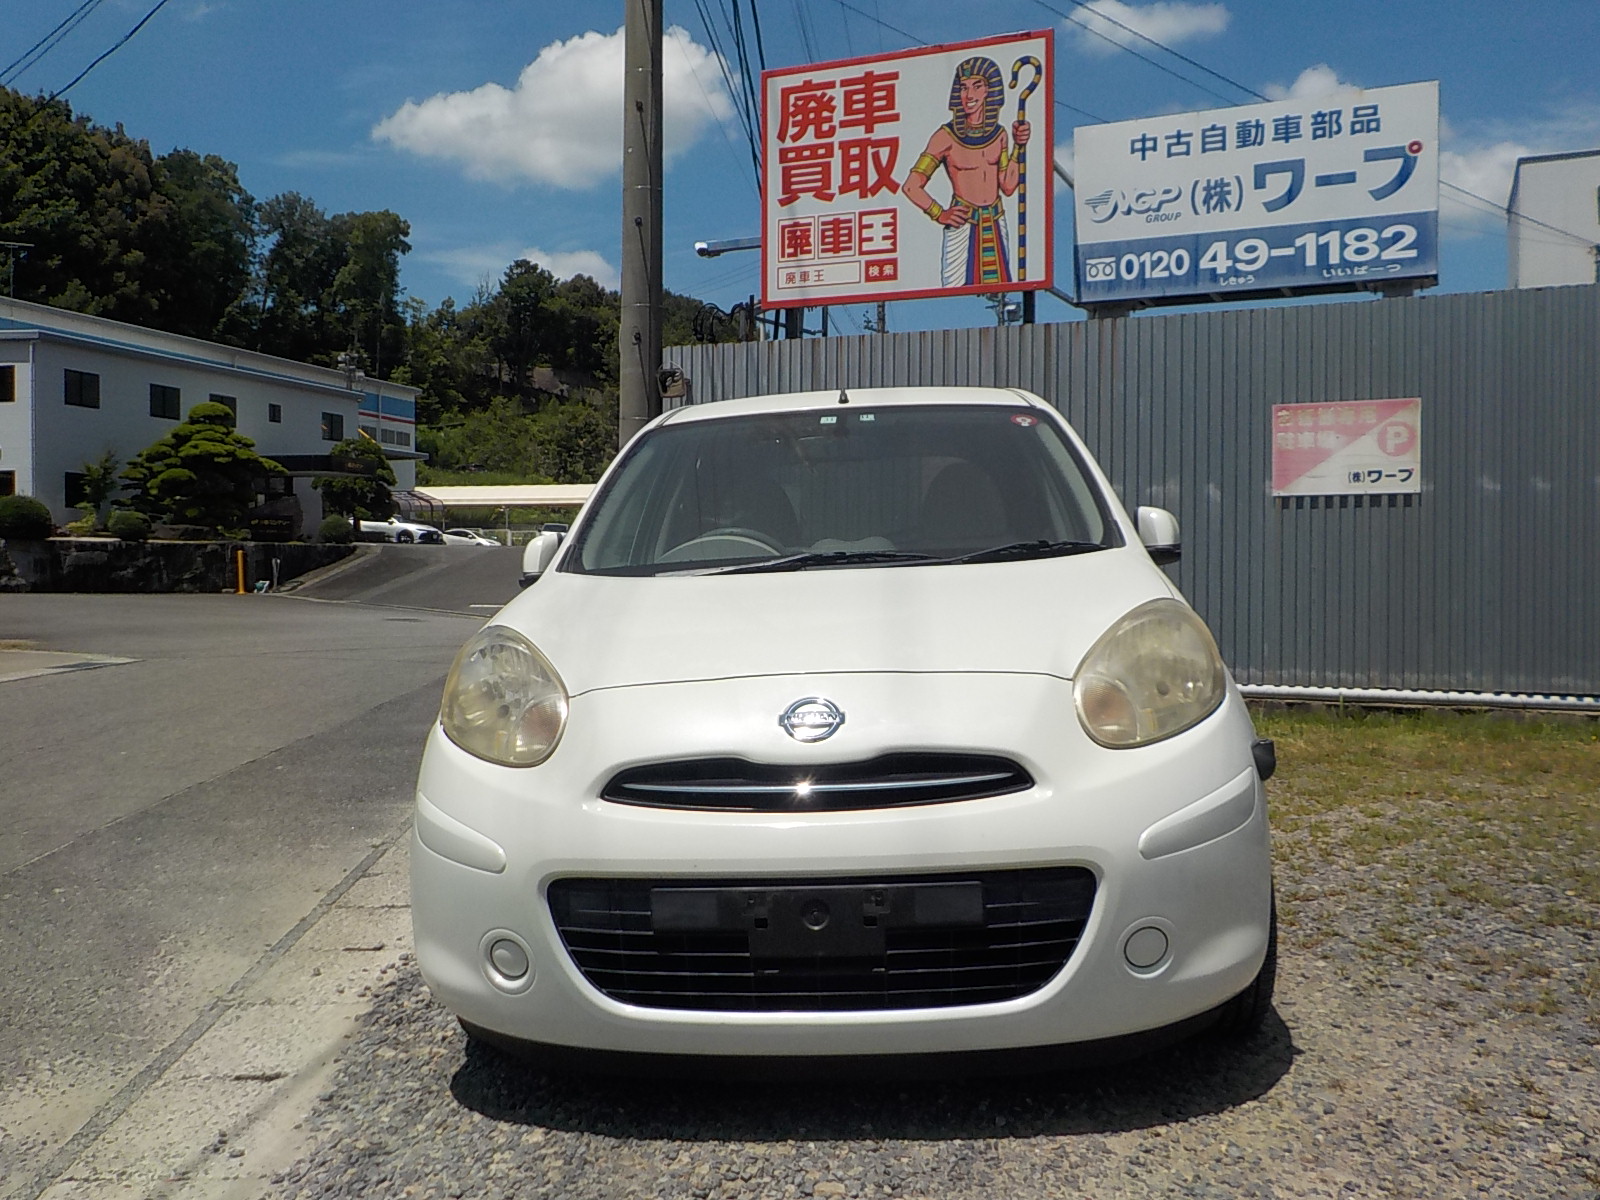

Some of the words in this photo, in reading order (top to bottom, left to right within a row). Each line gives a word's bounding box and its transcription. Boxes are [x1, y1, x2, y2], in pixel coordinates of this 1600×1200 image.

[777, 70, 900, 143] 廃車
[1130, 104, 1381, 162] 中古自動車部品
[777, 136, 901, 207] 買取
[780, 207, 898, 259] 廃車王
[1145, 212, 1182, 223] GROUP
[785, 269, 825, 284] 廃車王
[868, 264, 894, 277] 検索
[1119, 249, 1190, 281] 0120
[1199, 224, 1418, 275] 49-1182
[1386, 427, 1409, 453] P
